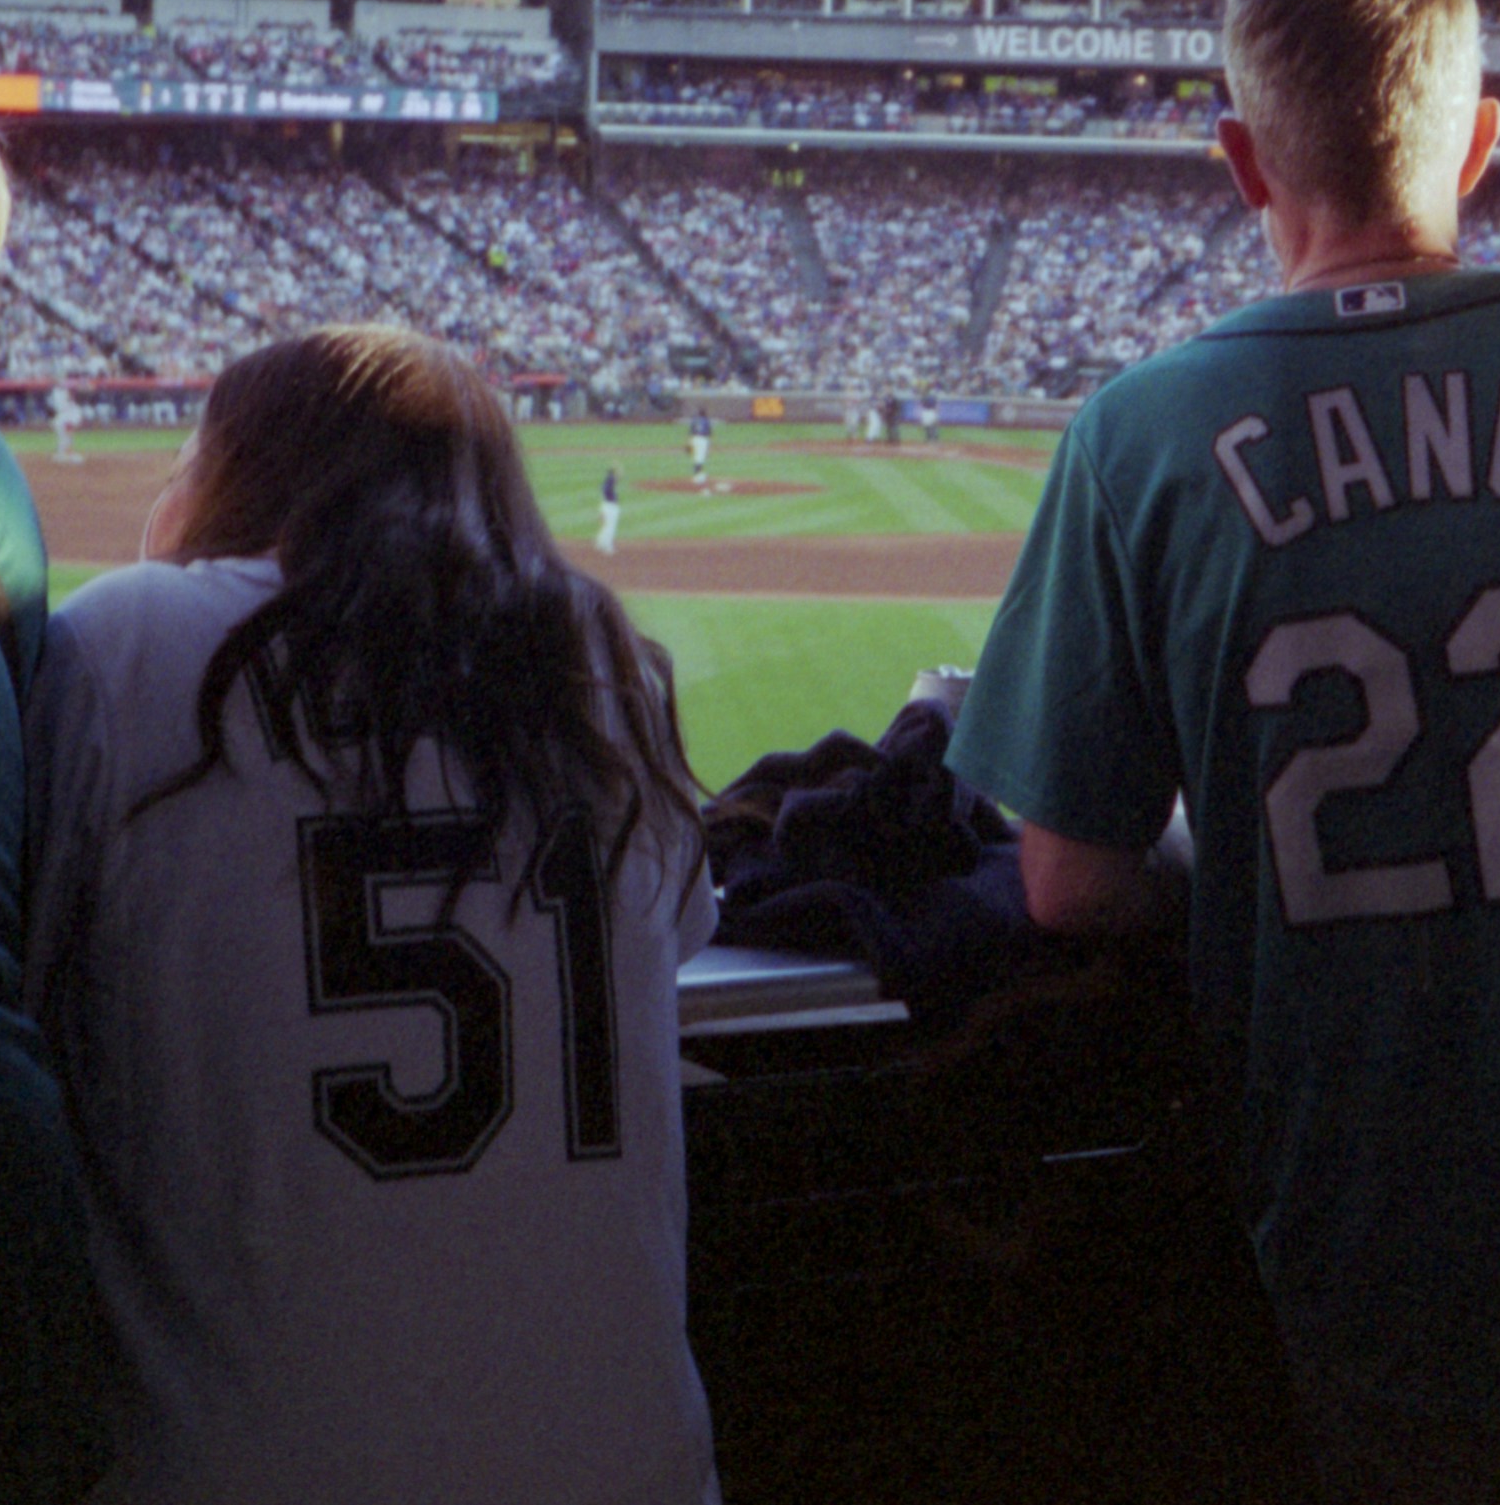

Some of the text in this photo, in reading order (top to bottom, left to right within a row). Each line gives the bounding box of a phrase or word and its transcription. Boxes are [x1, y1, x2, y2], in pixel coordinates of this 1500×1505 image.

[973, 25, 1214, 63] WELCOME TO
[299, 800, 624, 1182] 51
